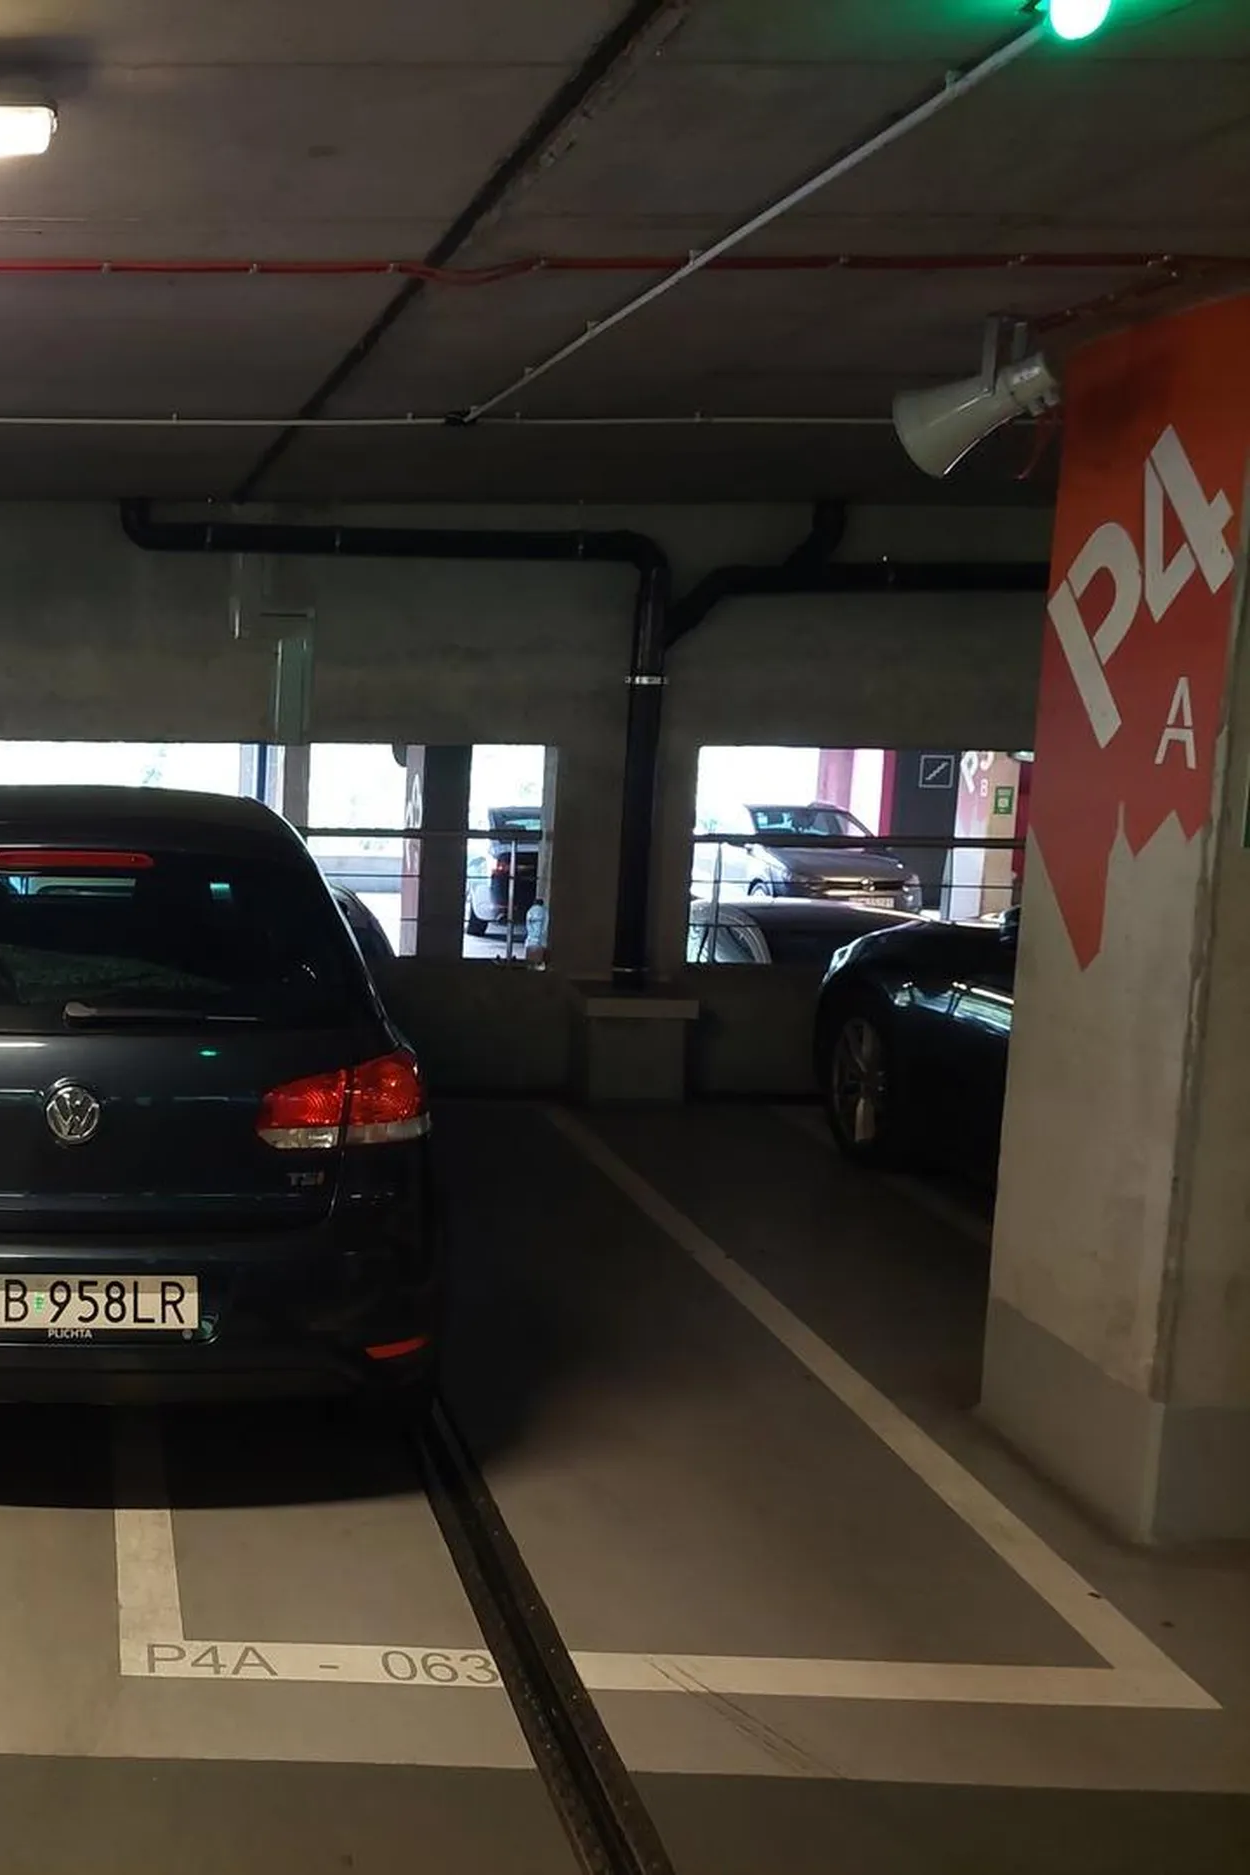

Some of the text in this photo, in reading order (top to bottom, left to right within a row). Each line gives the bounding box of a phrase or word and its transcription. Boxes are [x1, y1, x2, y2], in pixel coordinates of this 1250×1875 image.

[1047, 424, 1236, 749] P4
[1154, 677, 1197, 769] A
[49, 1280, 186, 1325] 958LR
[47, 1329, 93, 1340] PLICHTA
[146, 1643, 279, 1677] P4A
[380, 1649, 501, 1685] 063
